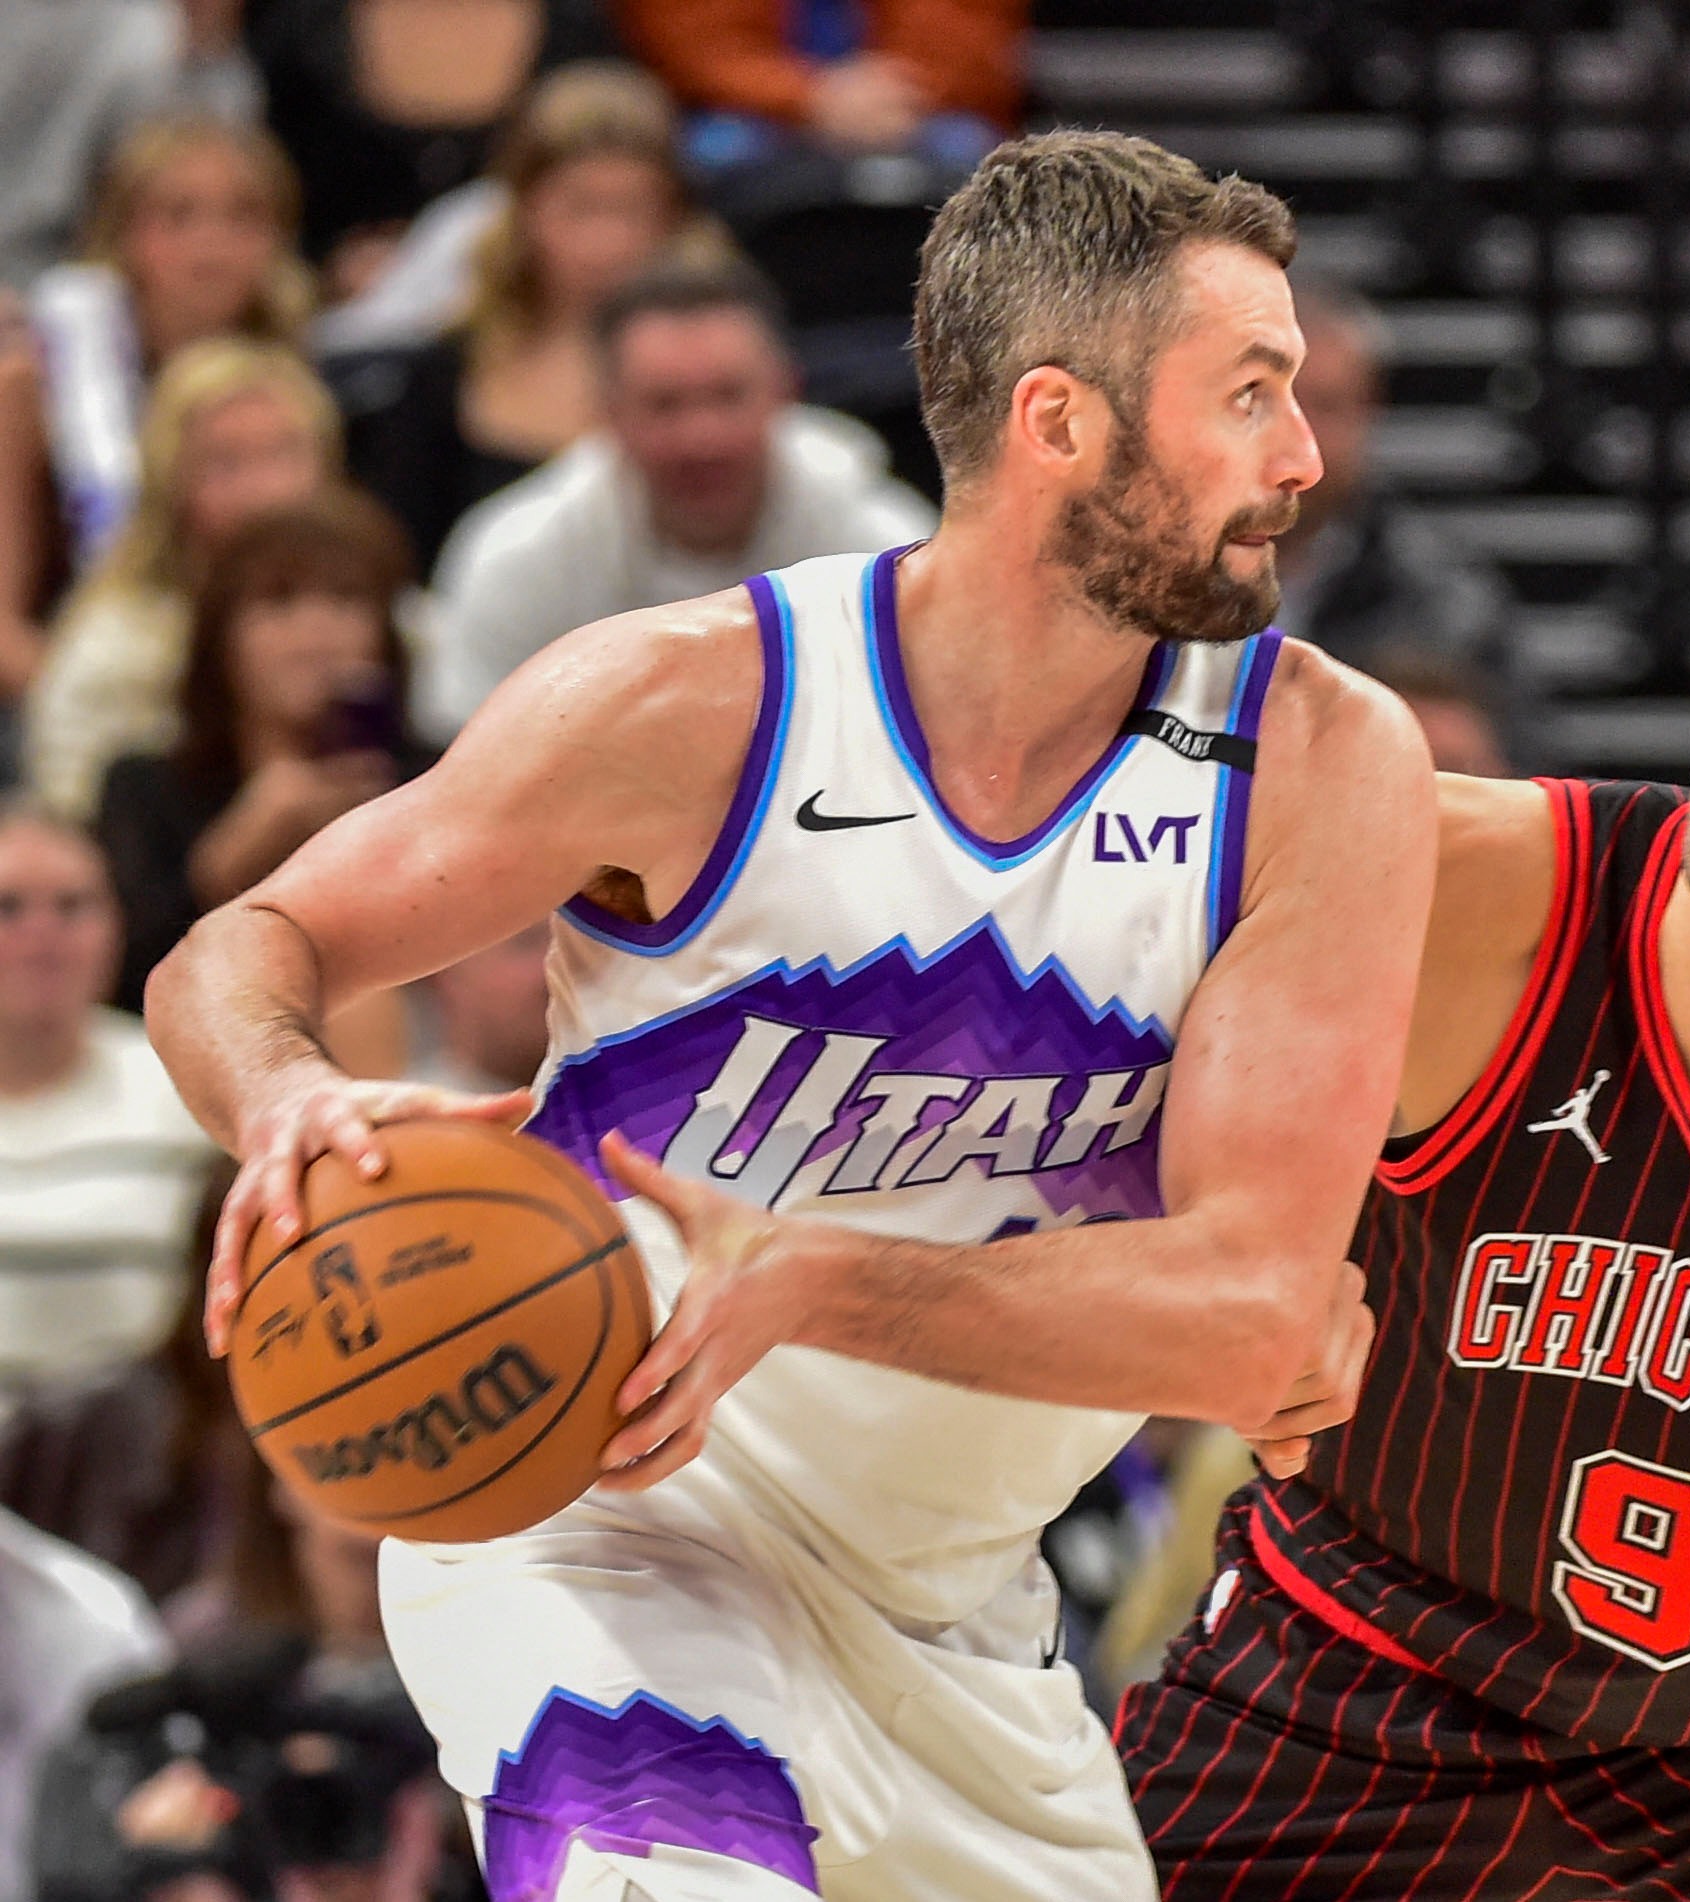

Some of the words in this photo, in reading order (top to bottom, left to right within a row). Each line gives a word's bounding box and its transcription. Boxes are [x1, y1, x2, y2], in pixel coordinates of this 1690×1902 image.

[1092, 811, 1202, 865] LVT
[661, 1012, 1173, 1210] UTAH
[296, 1343, 558, 1485] Wilson
